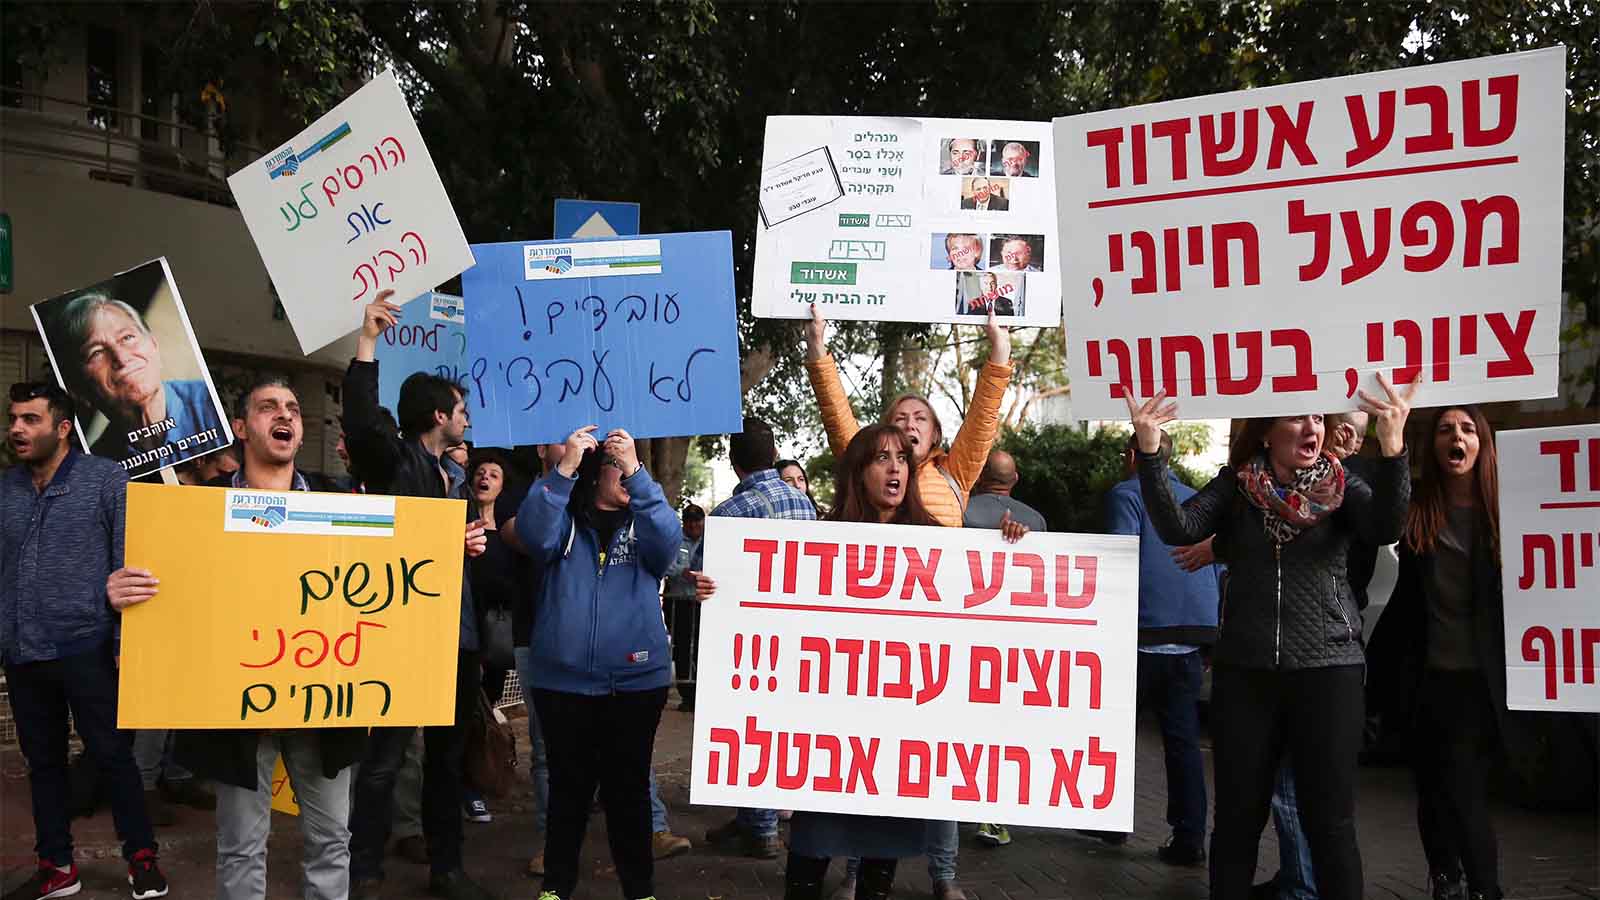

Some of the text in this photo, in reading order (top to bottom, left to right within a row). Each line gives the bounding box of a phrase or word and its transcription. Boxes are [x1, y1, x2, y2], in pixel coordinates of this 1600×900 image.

[1087, 75, 1520, 189] טבע אשדוד
[322, 136, 406, 208] הורסים
[347, 202, 391, 244] את
[1092, 195, 1520, 306] מפעל חיוני,
[352, 231, 428, 300] הבית
[799, 268, 849, 281] אשדוד
[790, 288, 887, 305] זה הבית שלי
[648, 348, 716, 404] לא
[1087, 309, 1537, 400] ציוני, בטחוני
[127, 418, 177, 443] אוהבים
[177, 428, 219, 451] זוכרים
[232, 494, 287, 505] ההסתדרות
[300, 557, 441, 615] אנשים
[743, 538, 1097, 609] טבע אשדוד
[1518, 533, 1600, 590] יות
[239, 620, 388, 668] לפני
[799, 635, 951, 705] עבודה
[240, 680, 391, 722] רווחים
[968, 645, 1102, 710] רוצים
[707, 715, 1117, 810] לא רוצים אבטלה
